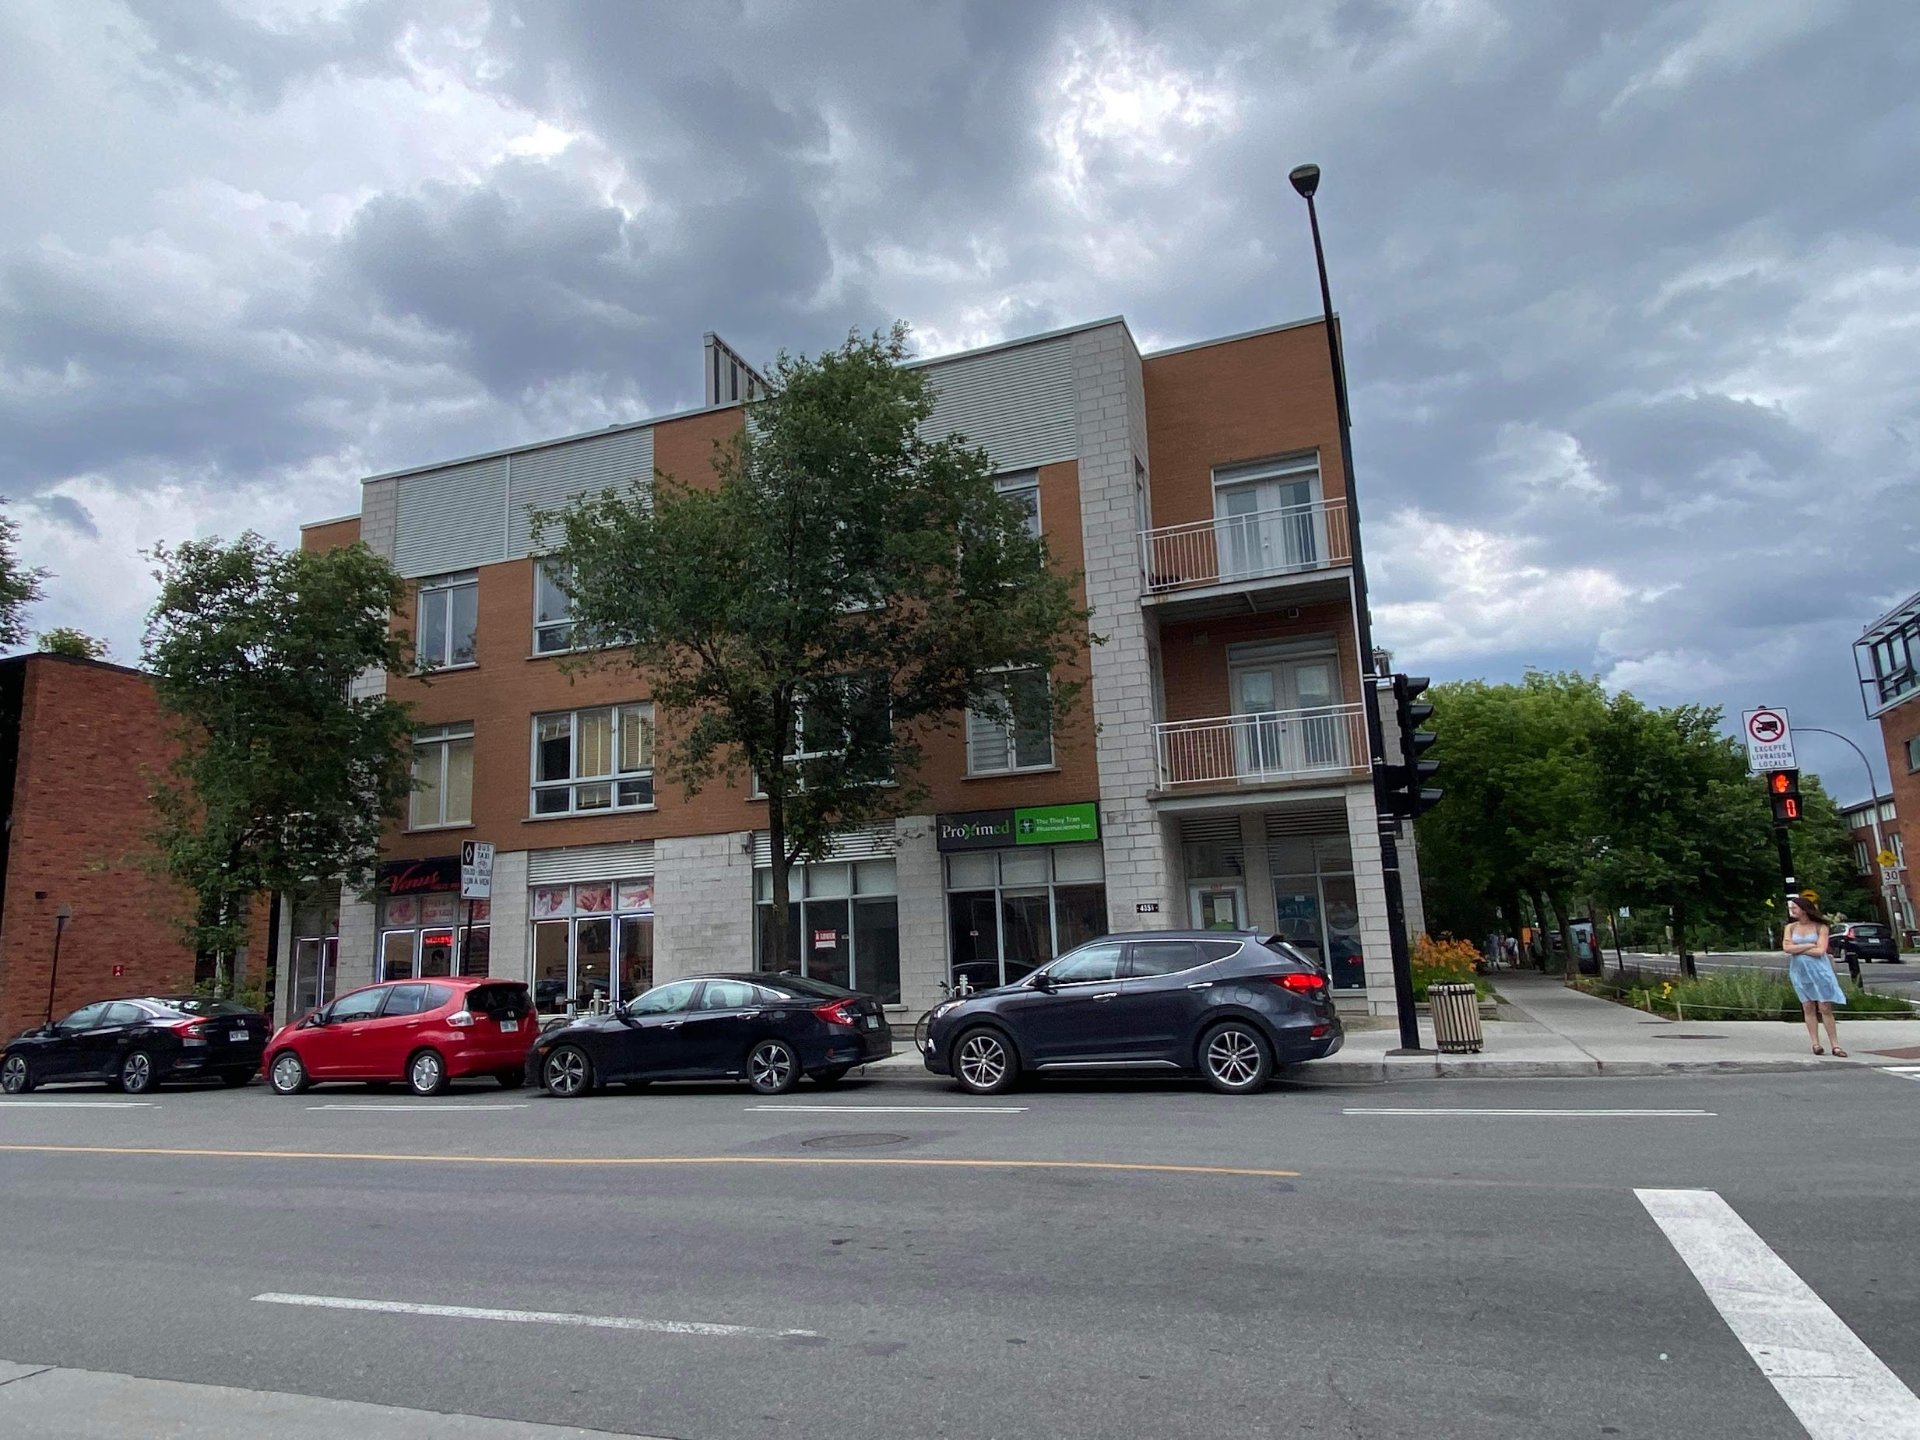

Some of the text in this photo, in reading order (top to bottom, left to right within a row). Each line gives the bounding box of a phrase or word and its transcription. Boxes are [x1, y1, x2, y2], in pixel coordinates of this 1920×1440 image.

[1752, 752, 1792, 761] LIVRAISON
[1786, 799, 1797, 817] 0
[388, 865, 440, 893] Venus
[1884, 870, 1898, 880] 30
